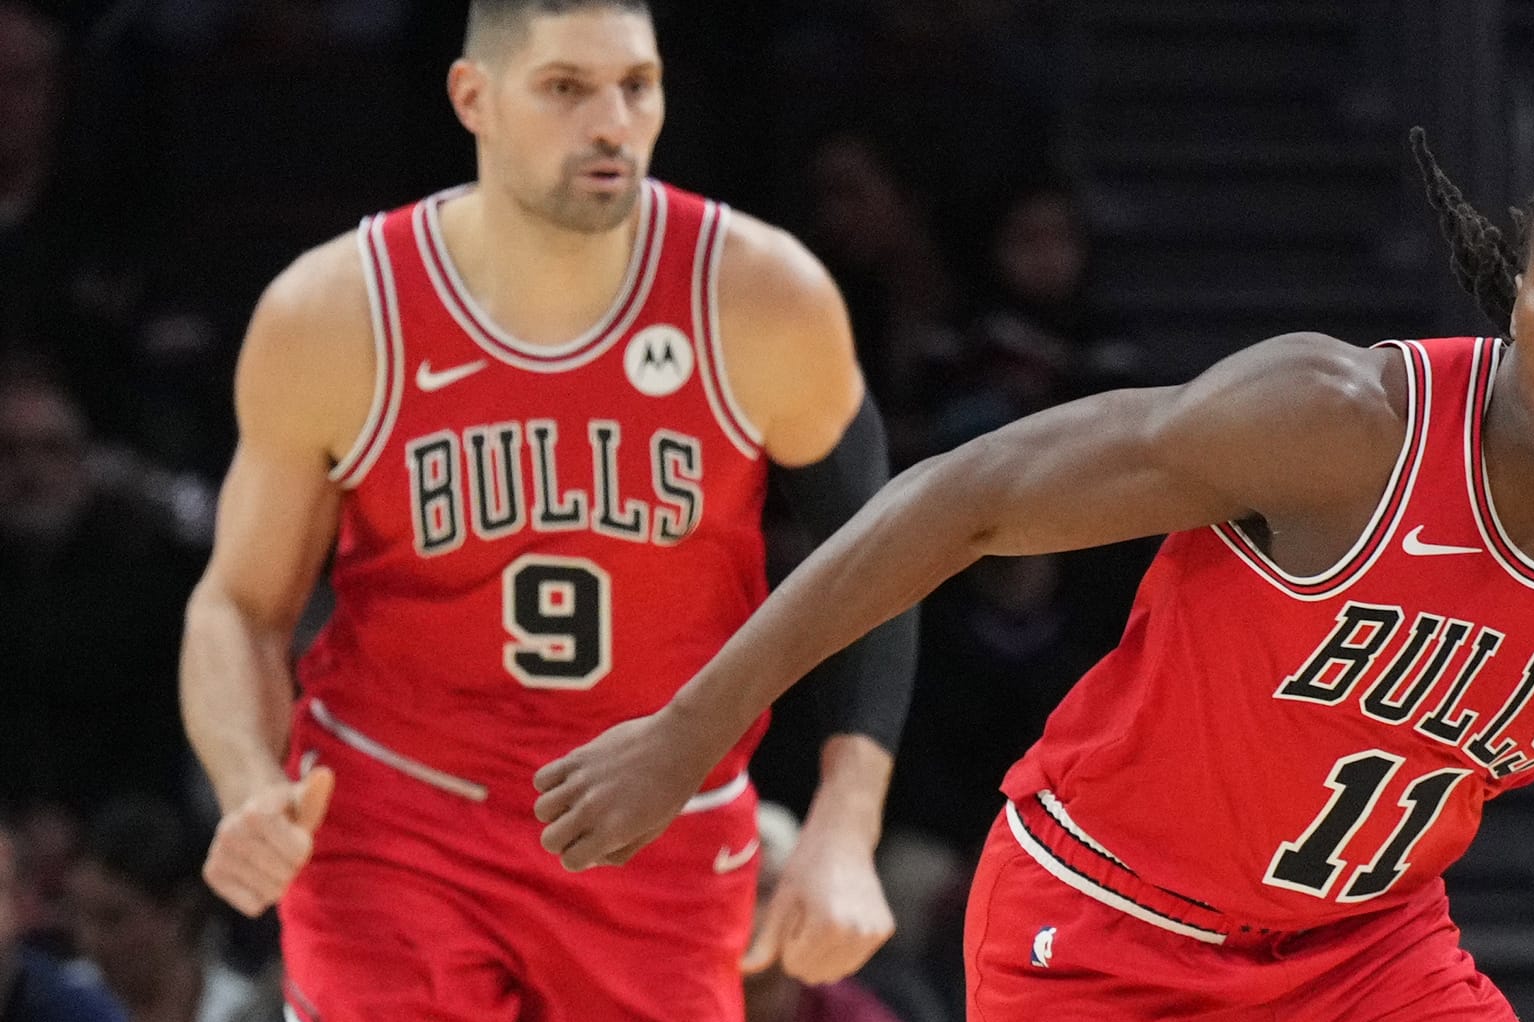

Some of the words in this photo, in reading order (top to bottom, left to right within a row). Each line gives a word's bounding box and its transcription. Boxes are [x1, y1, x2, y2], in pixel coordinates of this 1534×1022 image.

[405, 418, 703, 557] BULLS
[502, 553, 612, 691] 9
[1262, 748, 1475, 903] 11
